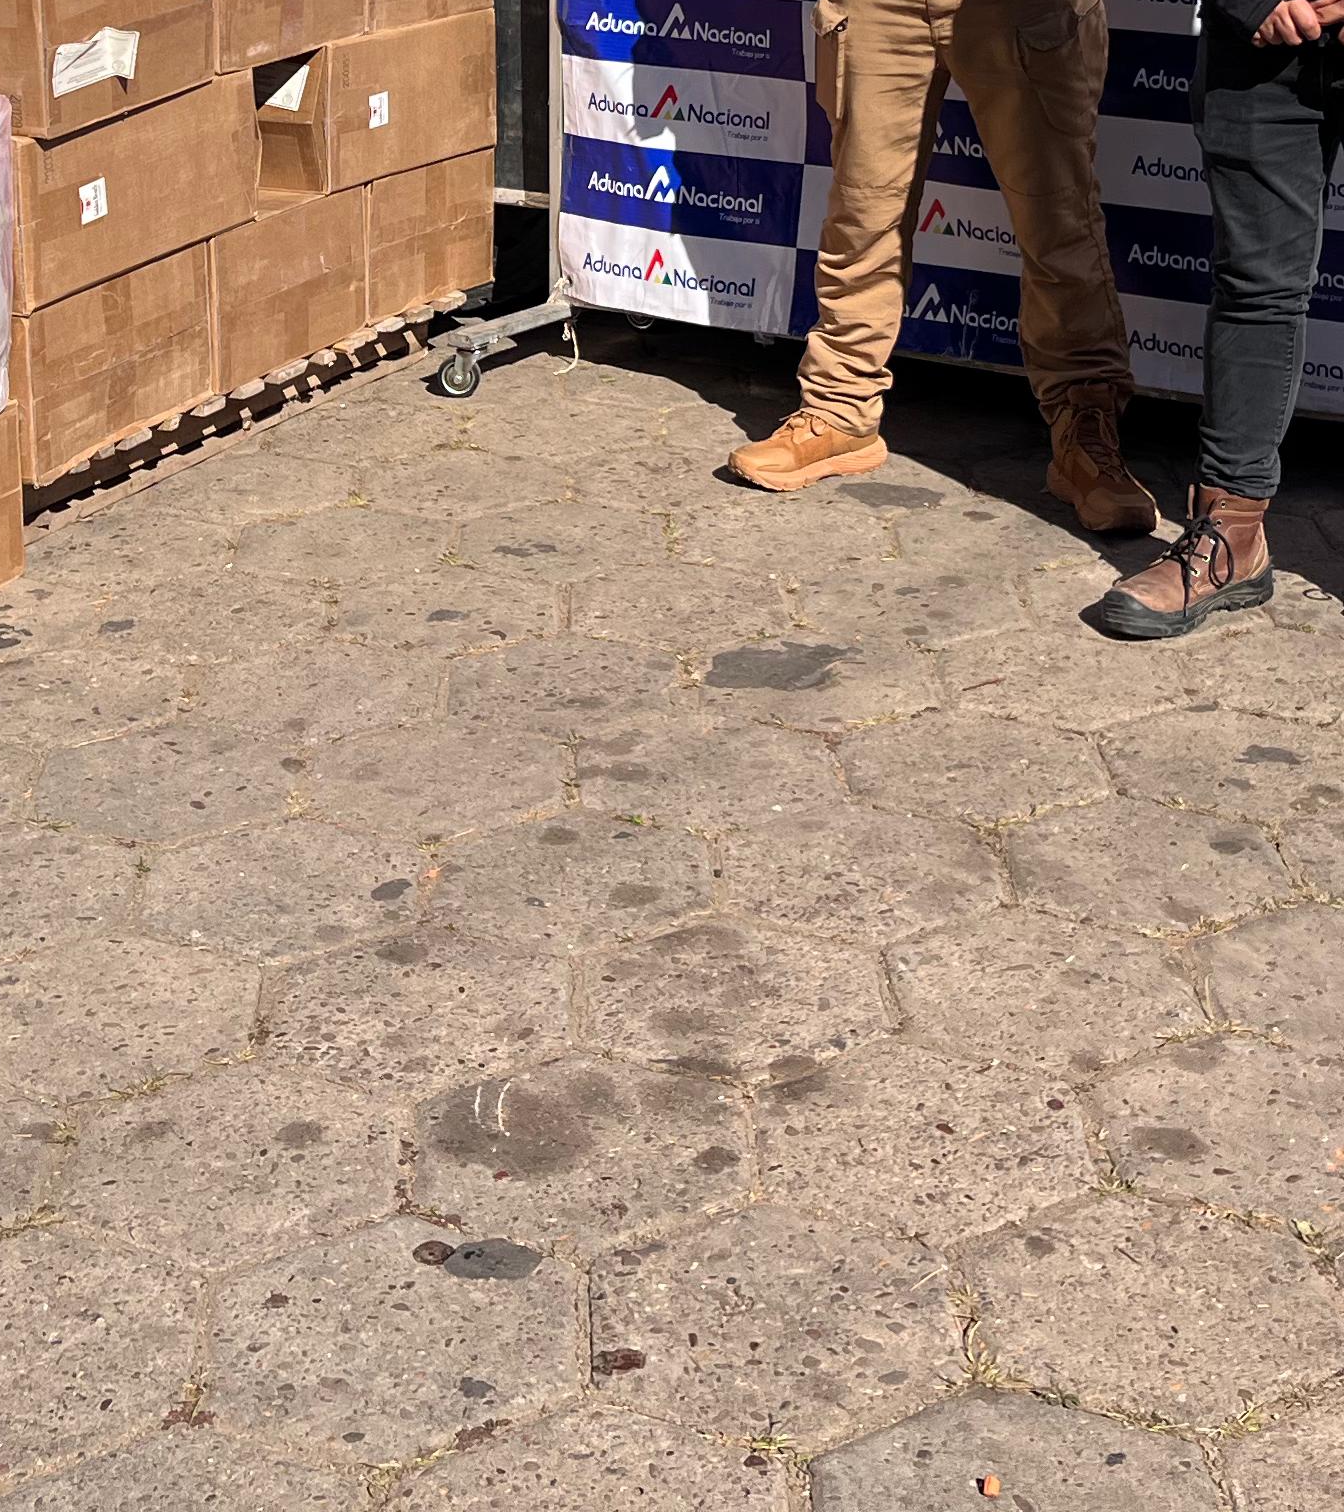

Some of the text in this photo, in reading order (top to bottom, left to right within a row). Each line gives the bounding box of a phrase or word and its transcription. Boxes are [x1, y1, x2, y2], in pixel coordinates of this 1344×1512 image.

[586, 11, 770, 49] Aduana Nacional
[588, 171, 762, 214] Aduana Nacional
[583, 252, 755, 297] Aduana Nacional
[1128, 244, 1209, 272] Aduana
